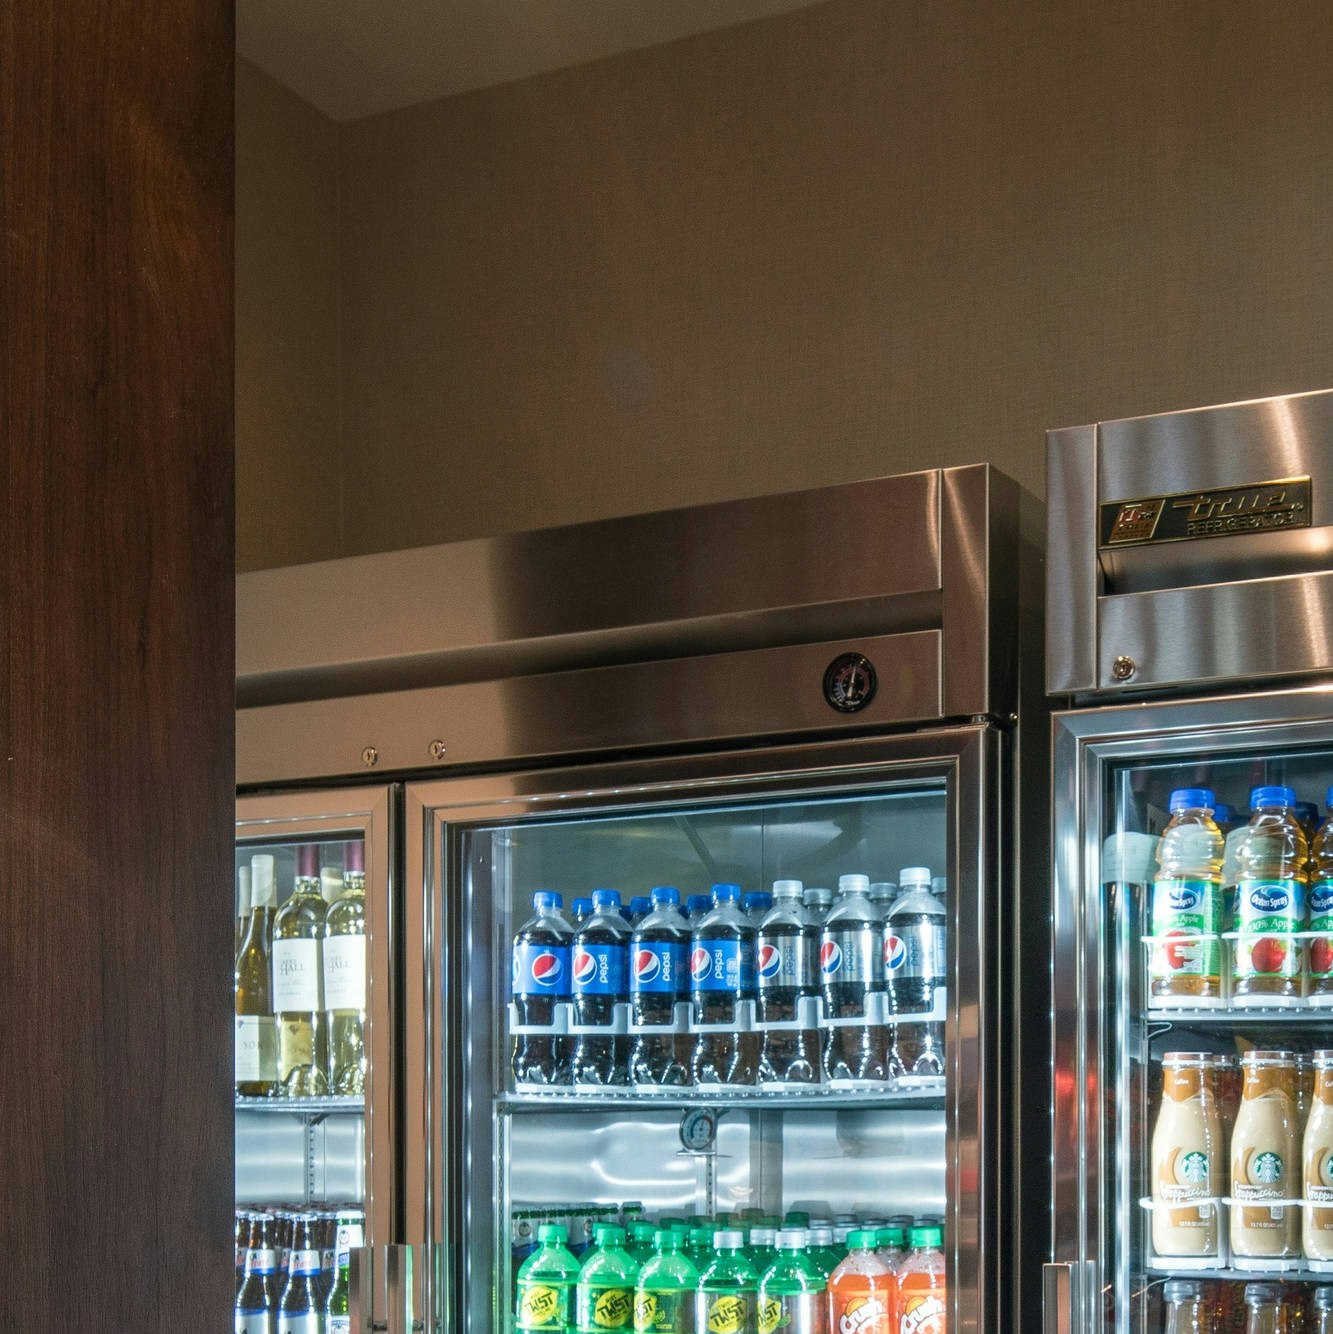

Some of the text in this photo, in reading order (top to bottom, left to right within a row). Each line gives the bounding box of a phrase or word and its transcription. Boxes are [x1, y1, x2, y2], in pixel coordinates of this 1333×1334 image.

[599, 953, 608, 984] pepsi
[662, 951, 671, 982] pepsi
[714, 949, 723, 979] pepsi
